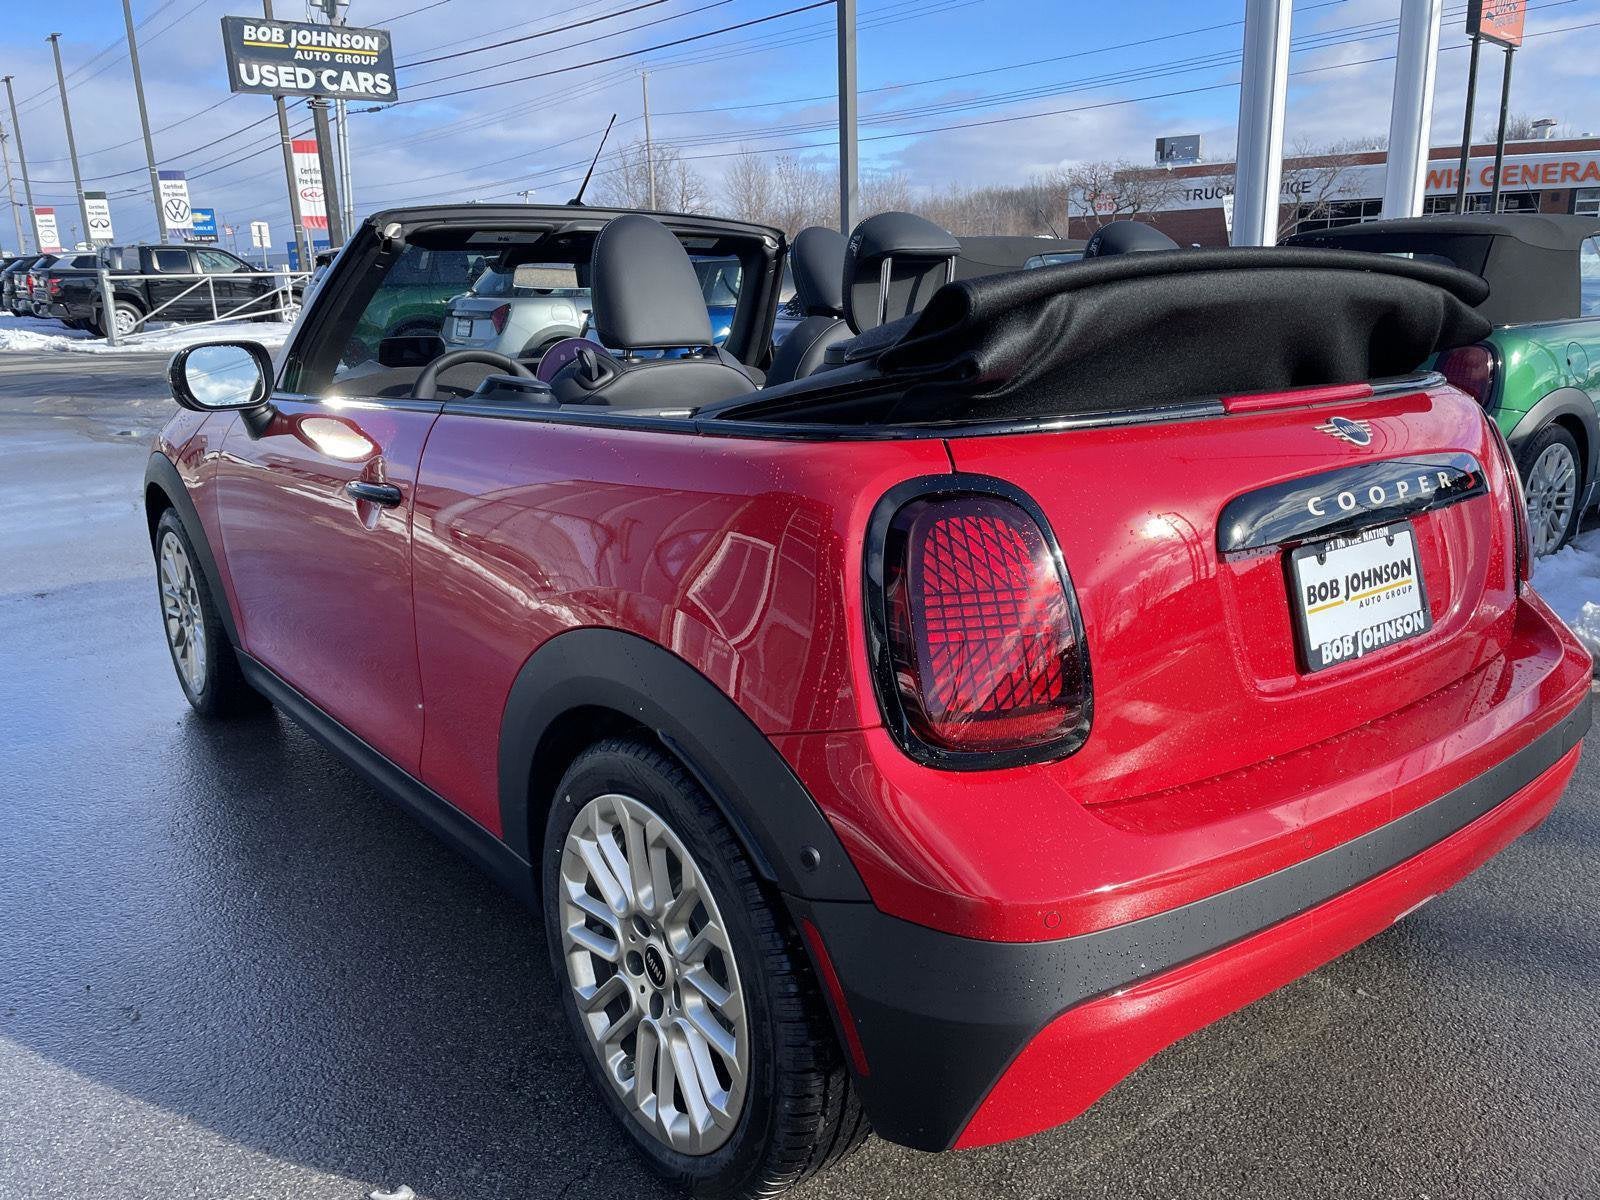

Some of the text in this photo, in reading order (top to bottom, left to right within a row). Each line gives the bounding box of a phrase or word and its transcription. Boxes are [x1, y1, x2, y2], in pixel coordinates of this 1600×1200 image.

[243, 25, 379, 51] BOB JOHNSON
[294, 50, 379, 66] AUTO GROUP
[239, 63, 392, 95] USED CARS
[1480, 161, 1600, 187] GENERA
[1307, 471, 1452, 516] COOPER
[1336, 538, 1346, 549] IN
[1362, 526, 1389, 541] NATION
[1306, 558, 1412, 606] BOB JOHNSON
[1359, 585, 1413, 609] AUTO GROUP
[1321, 610, 1425, 665] BOB JOHNSON
[646, 952, 663, 982] MINI
